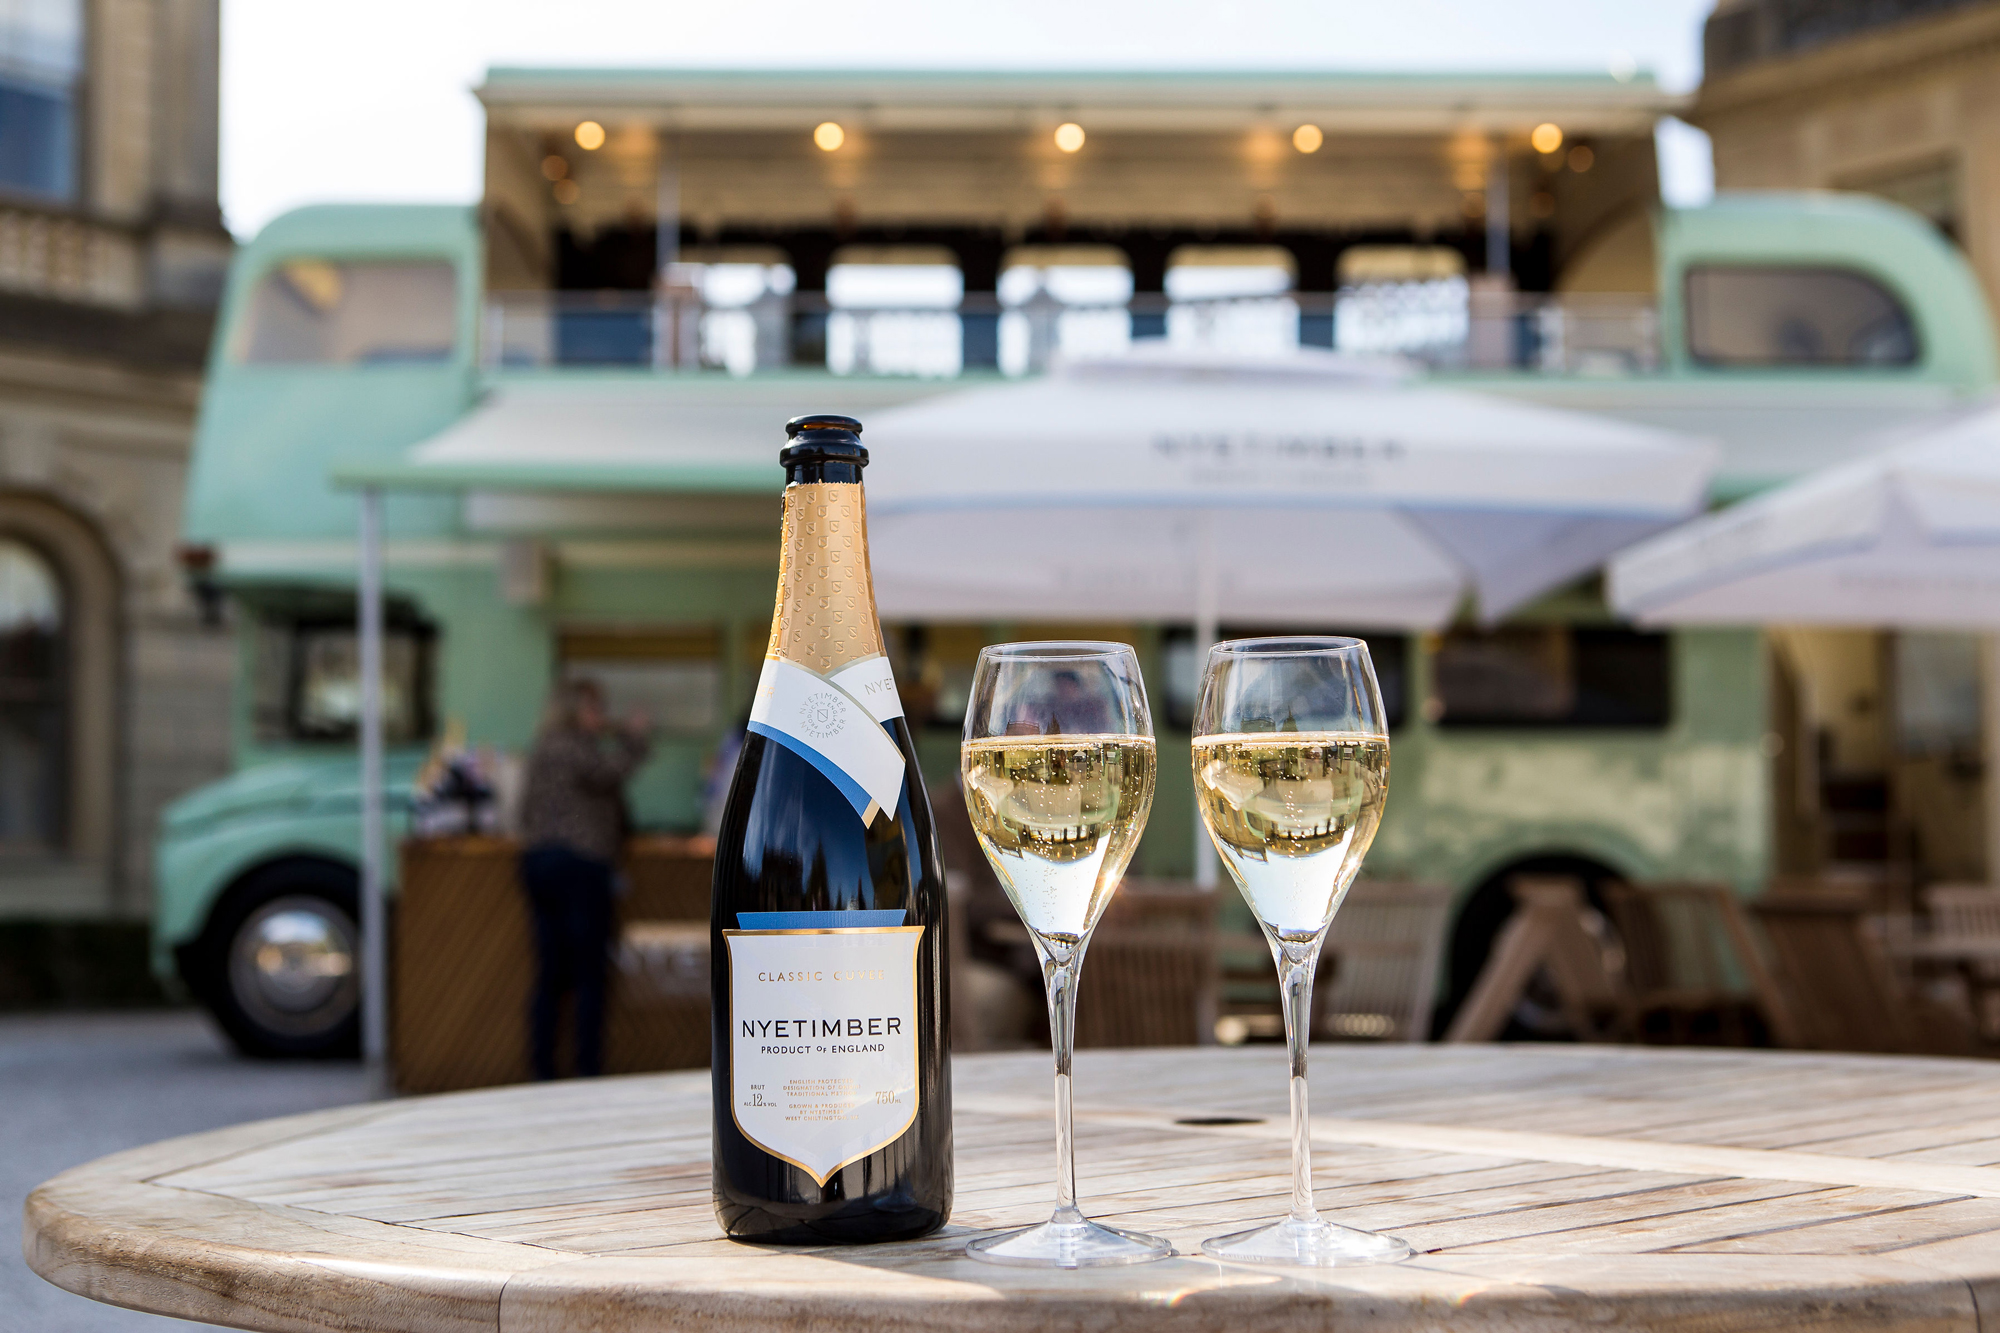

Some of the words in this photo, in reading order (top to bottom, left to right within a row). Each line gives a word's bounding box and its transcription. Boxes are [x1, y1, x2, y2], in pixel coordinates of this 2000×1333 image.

[799, 692, 847, 715] NYETIMBER
[799, 718, 847, 739] NYETIMBER
[757, 971, 823, 982] CLASSIC
[742, 1016, 902, 1038] NYETIMBER
[761, 1045, 811, 1055] PRODUCT
[831, 1043, 885, 1054] ENGLAND
